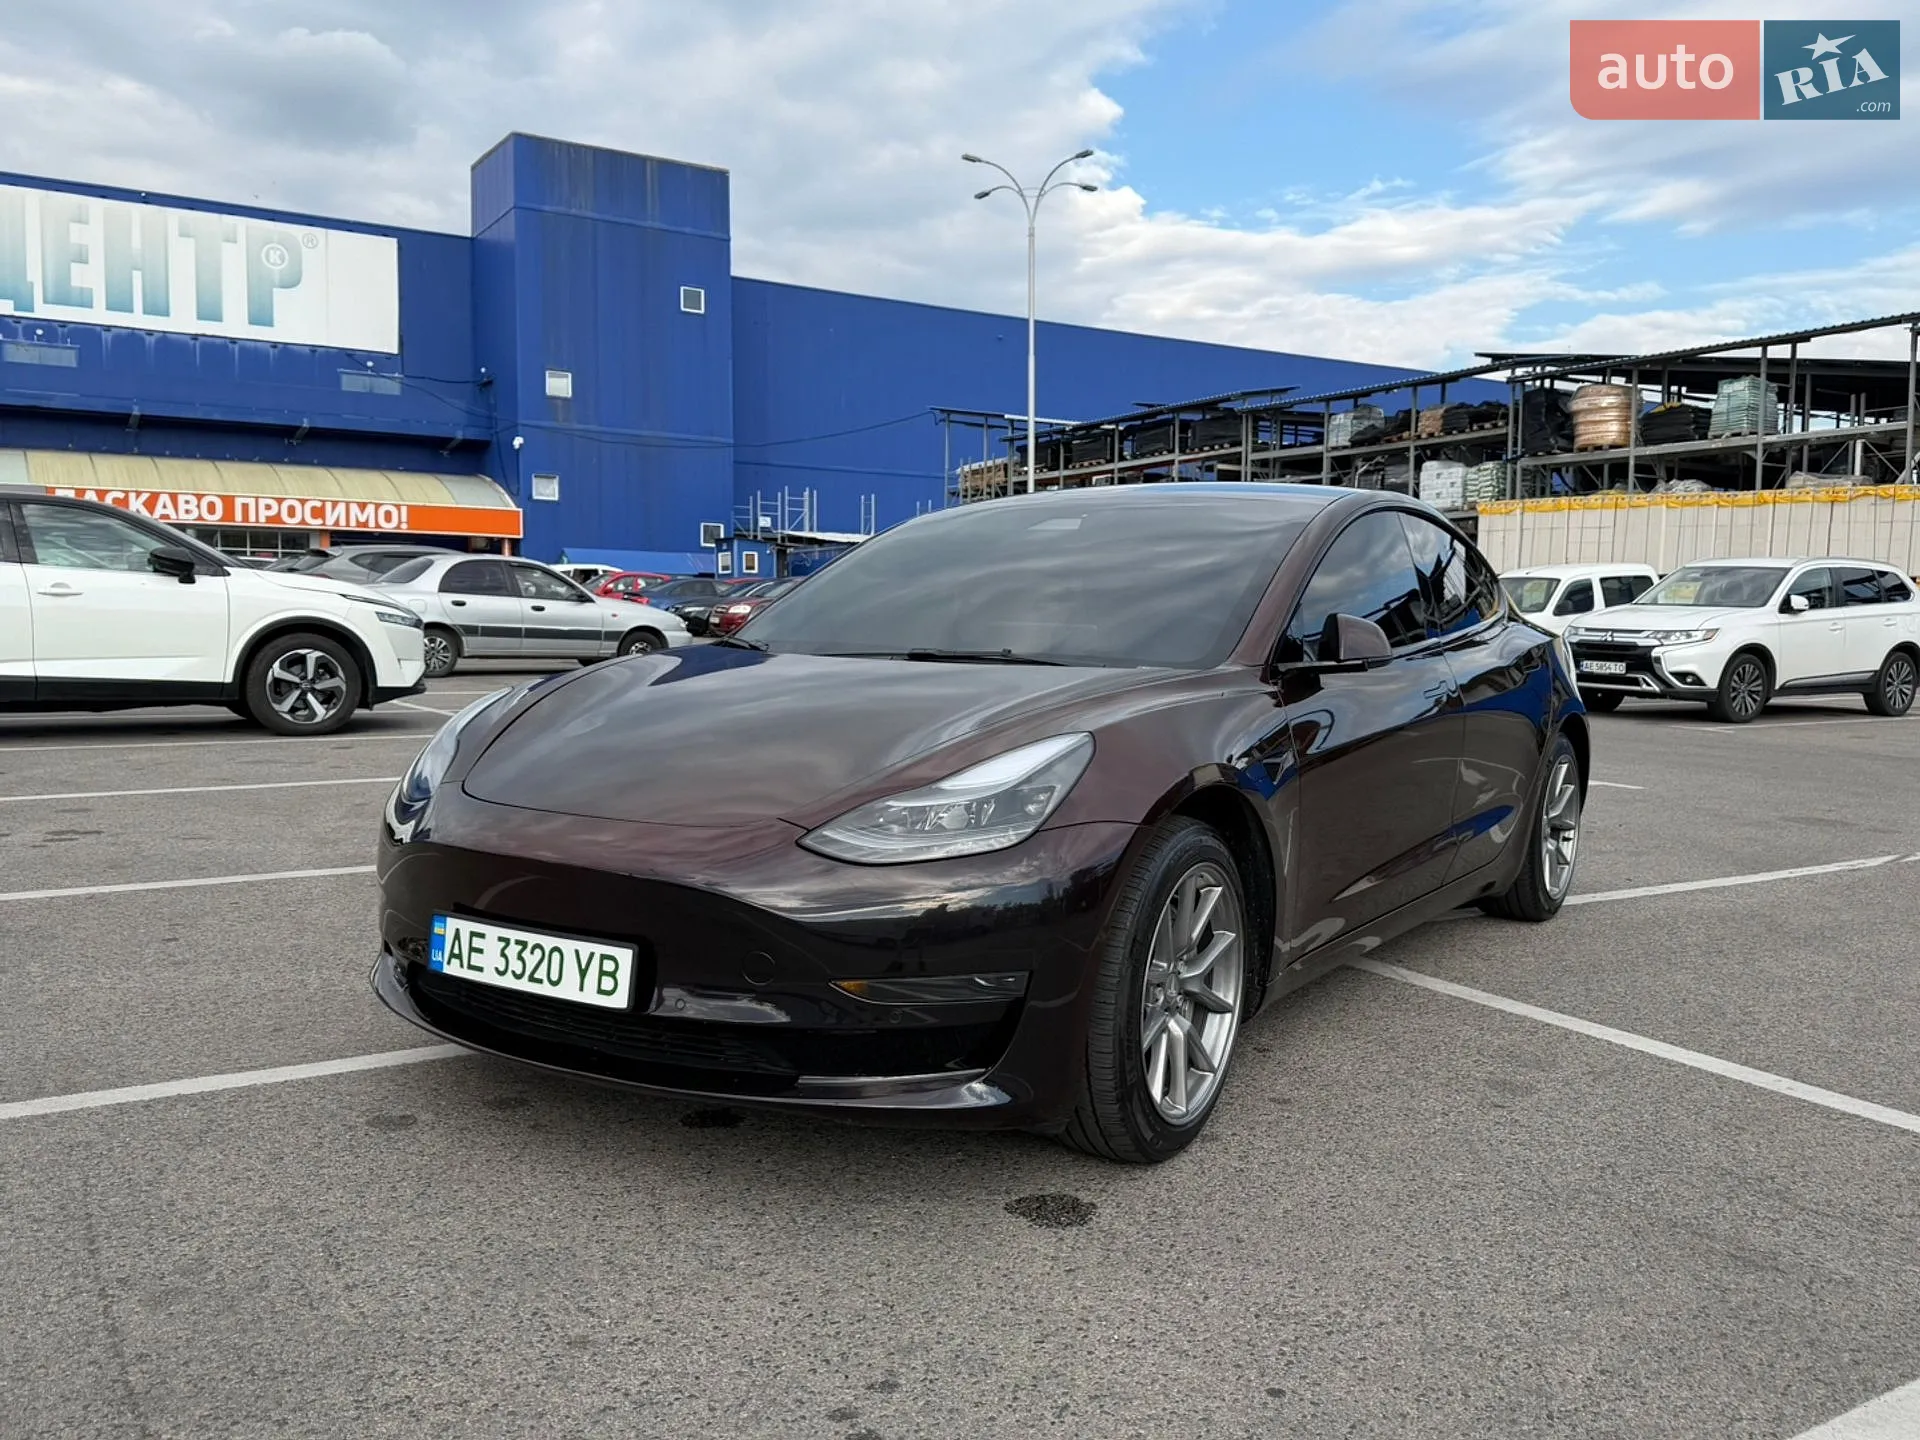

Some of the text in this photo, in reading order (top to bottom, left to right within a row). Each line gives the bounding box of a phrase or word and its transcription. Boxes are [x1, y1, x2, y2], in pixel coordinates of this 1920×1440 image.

[234, 496, 409, 530] ПРОСИМО!
[431, 948, 443, 962] UA
[446, 927, 620, 997] AE 3320 YB
